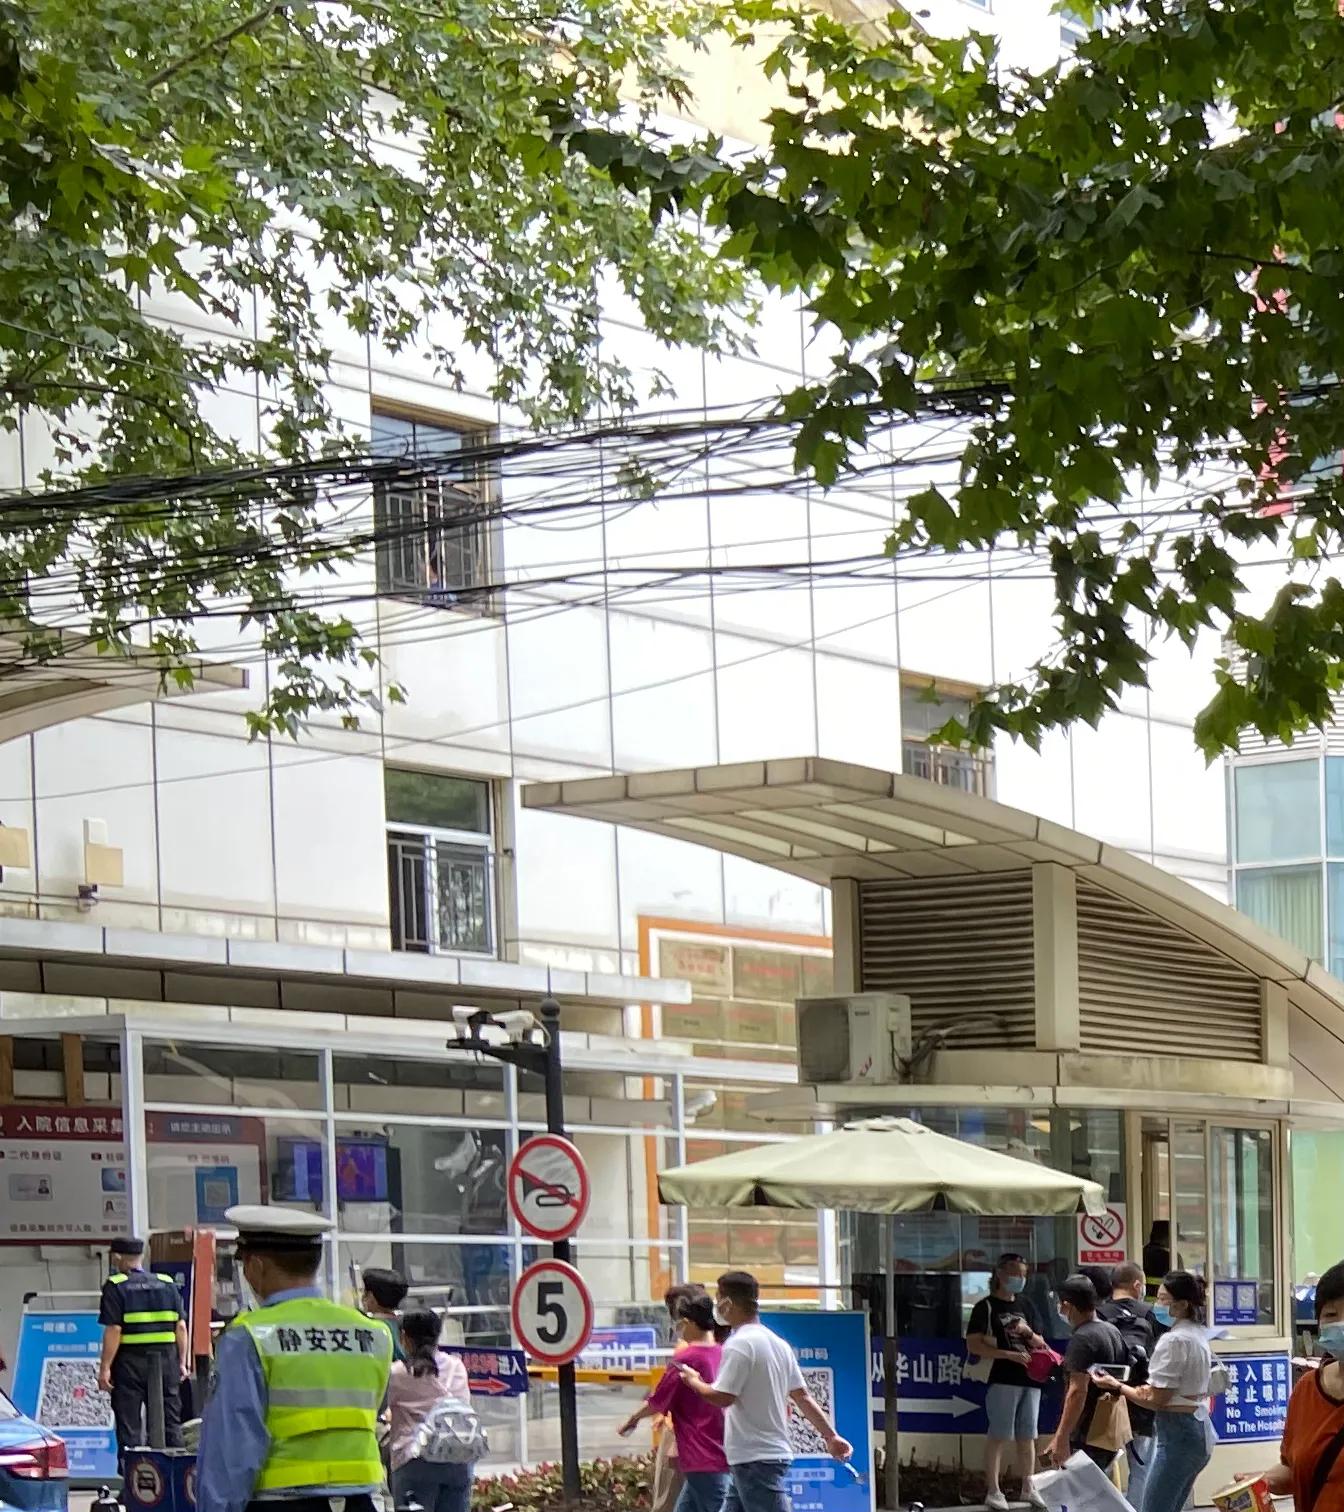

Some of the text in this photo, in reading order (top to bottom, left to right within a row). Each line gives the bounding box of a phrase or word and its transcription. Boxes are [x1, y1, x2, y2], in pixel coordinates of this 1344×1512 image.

[536, 1281, 568, 1344] 5
[276, 1327, 375, 1353] 静安交管
[1225, 1383, 1287, 1405] 禁止吸烟
[1226, 1407, 1241, 1419] No
[1226, 1422, 1237, 1433] In
[1238, 1421, 1257, 1432] The
